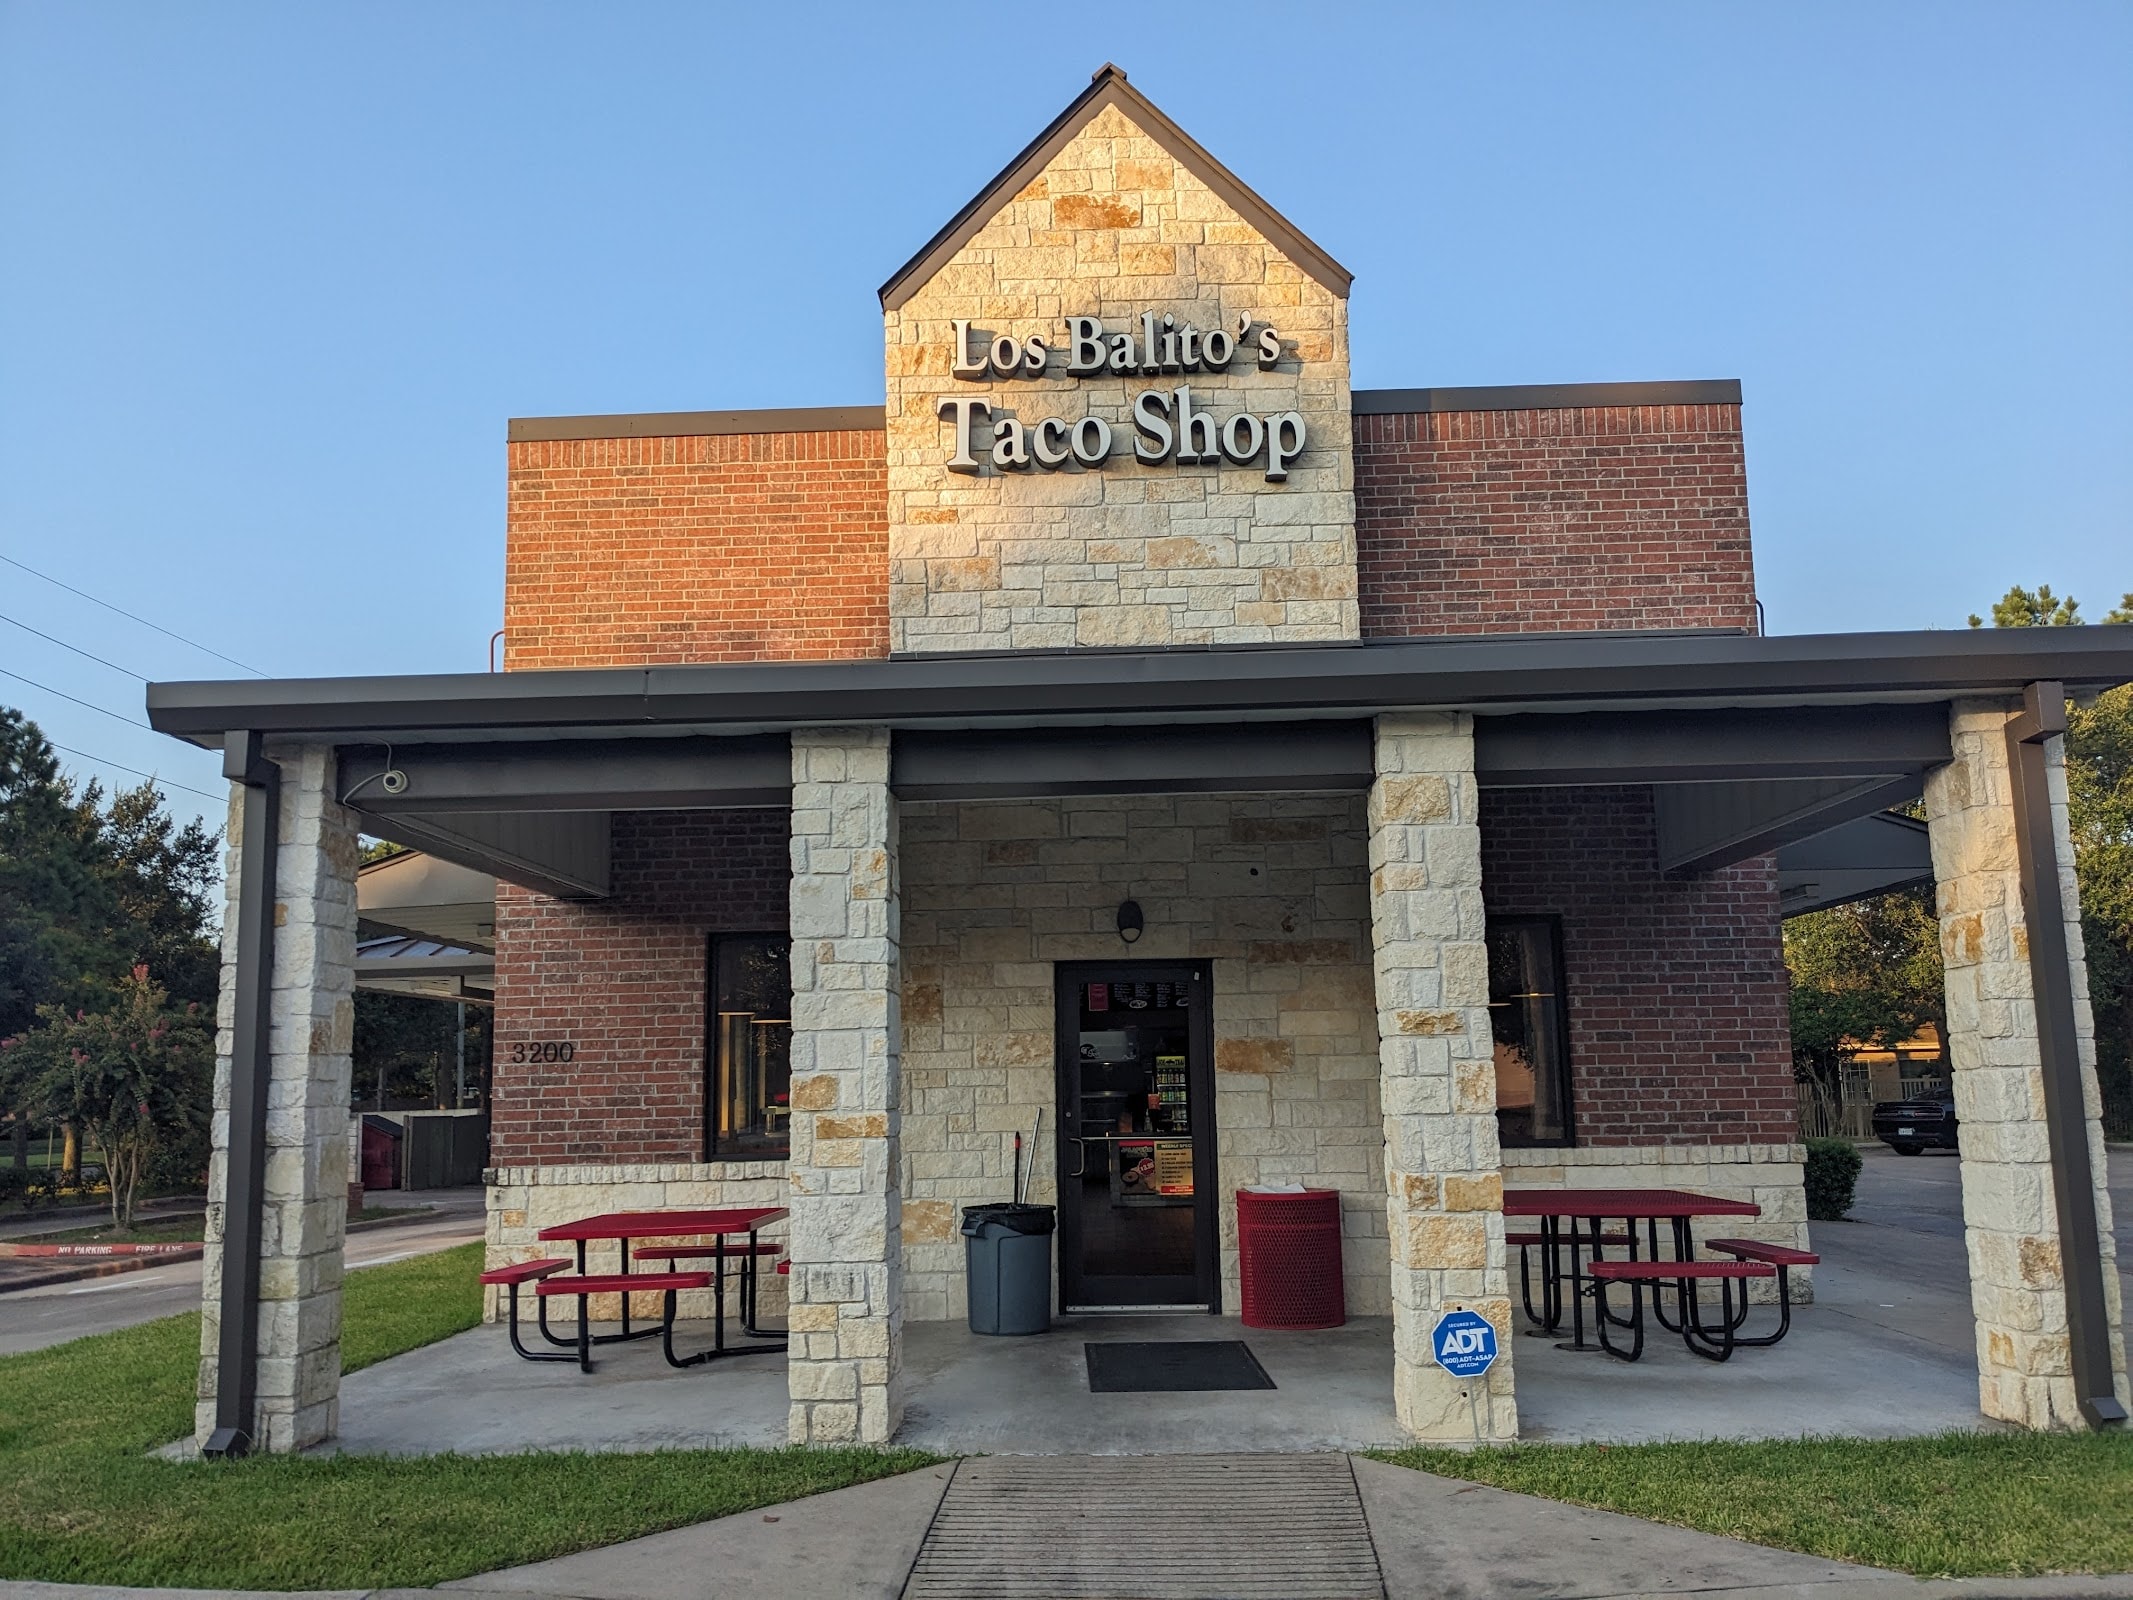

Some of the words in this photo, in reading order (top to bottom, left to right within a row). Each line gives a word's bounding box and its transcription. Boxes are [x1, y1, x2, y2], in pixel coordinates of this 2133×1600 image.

[950, 318, 1047, 379] Los
[1064, 309, 1280, 378] Balito's
[936, 396, 1112, 473] Taco
[1132, 383, 1307, 483] Shop
[512, 1042, 573, 1063] 3200
[58, 1246, 71, 1254] NO
[74, 1246, 112, 1254] PARKING
[135, 1245, 156, 1253] FIRE
[1441, 1327, 1489, 1356] ADT
[1459, 1354, 1492, 1362] ADT-ASAP
